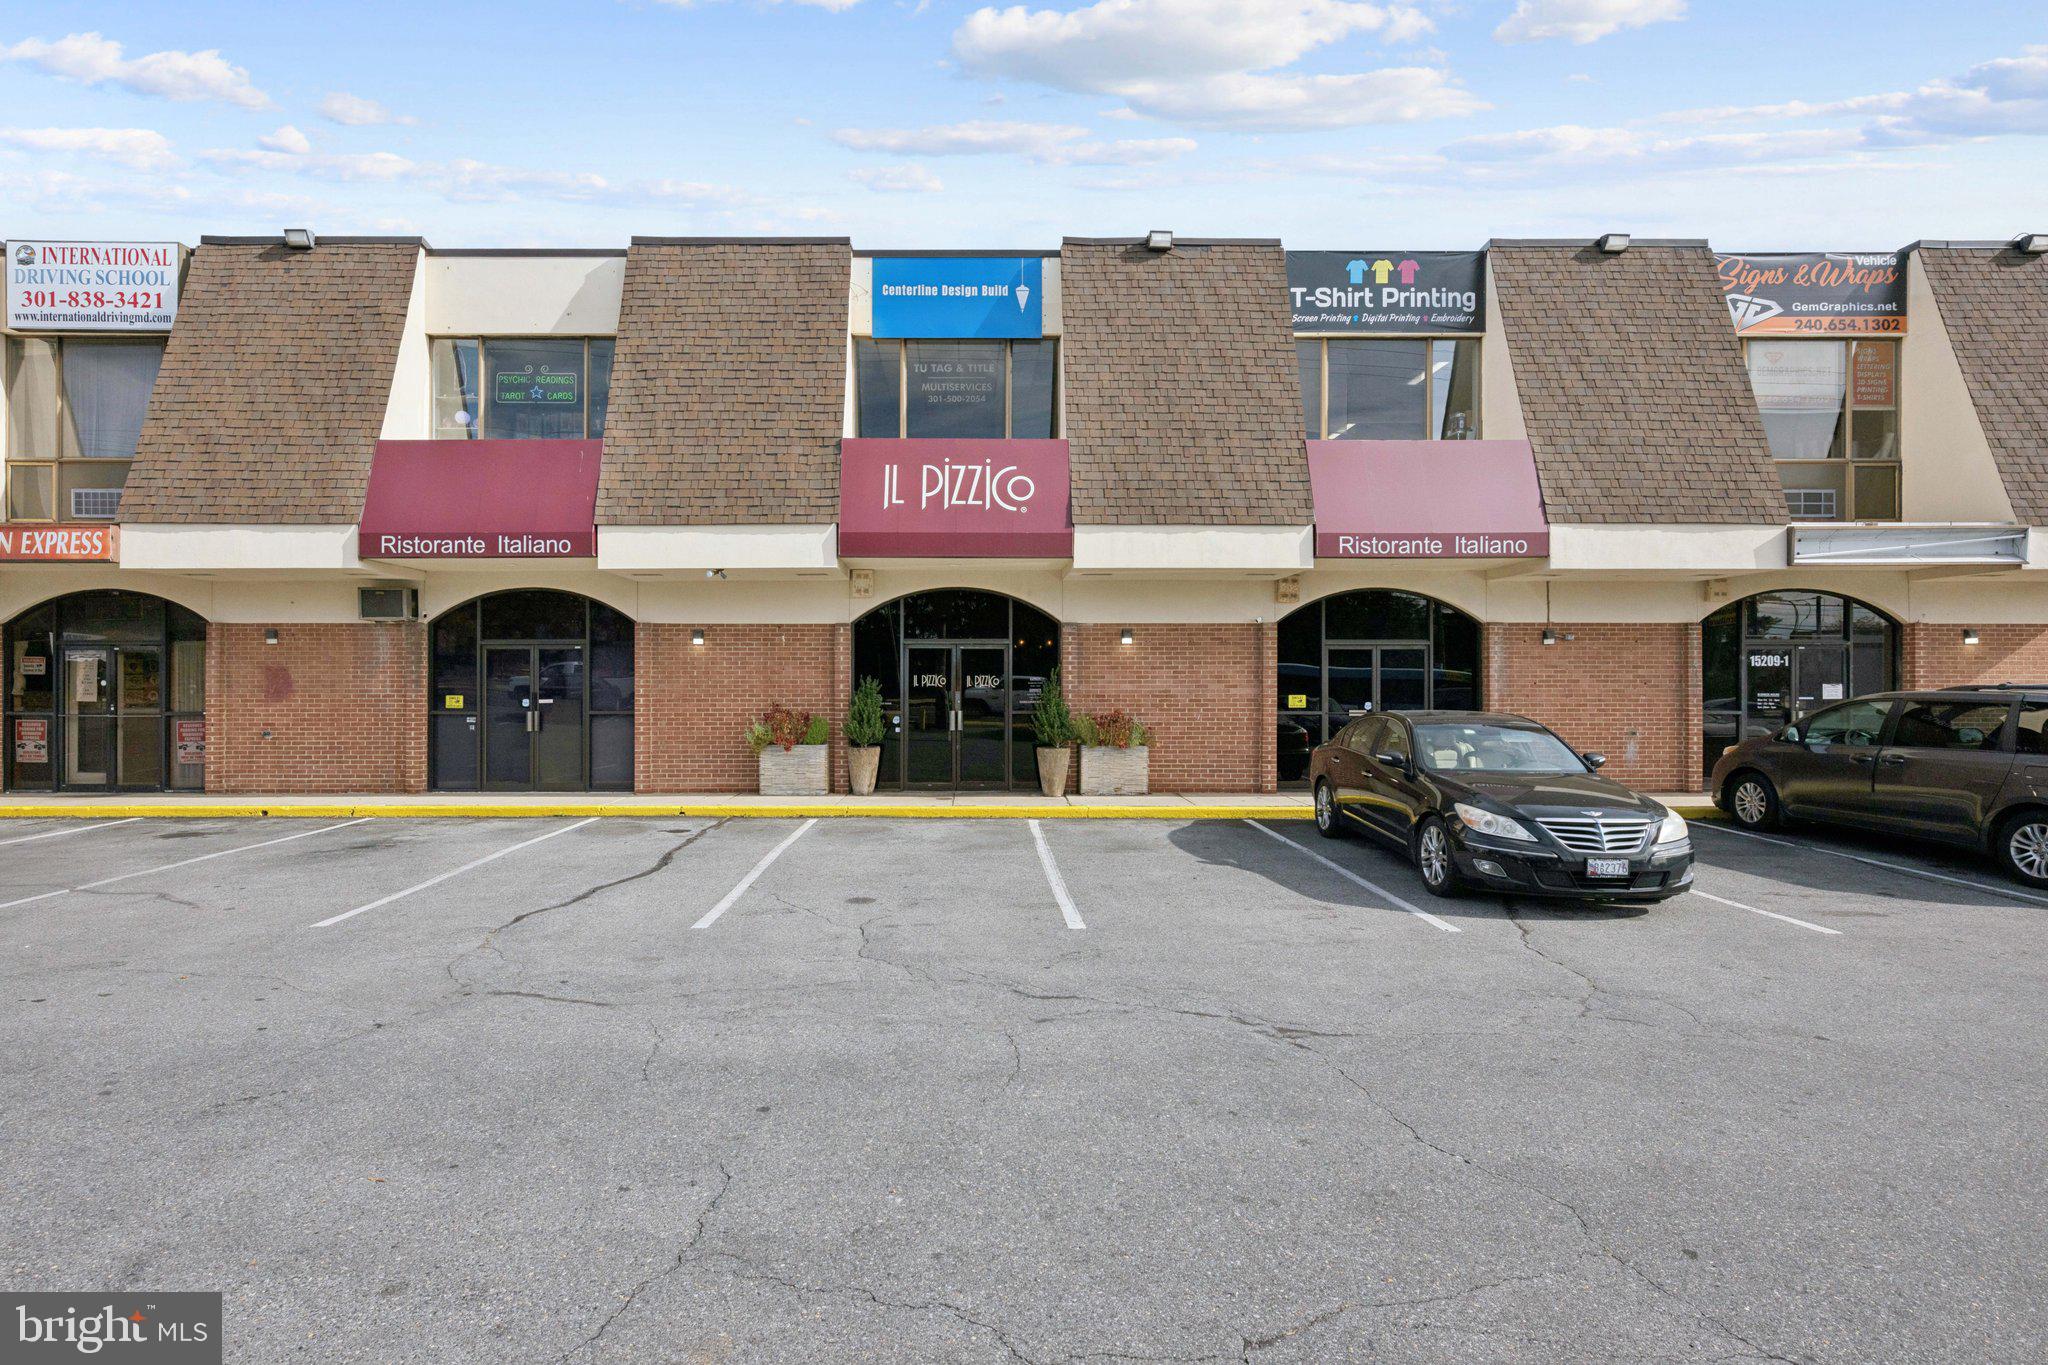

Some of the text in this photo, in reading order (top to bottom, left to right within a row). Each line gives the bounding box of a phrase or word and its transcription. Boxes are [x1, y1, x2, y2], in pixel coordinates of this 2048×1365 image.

[41, 246, 172, 267] INTERNATIONAL
[1854, 255, 1898, 266] Vehicle
[14, 268, 171, 286] DRIVING SCHOOL
[1716, 257, 1899, 295] Signs & Wraps
[882, 284, 1009, 298] Centerline Design Build
[21, 290, 163, 309] 301-838-3421
[1290, 287, 1476, 312] T-Shirt Printing
[1791, 302, 1898, 313] GemGraphics.net
[14, 310, 172, 325] www.internationaldrivingmd.com
[1292, 313, 1475, 325] Screen Printing Digital Printing Embroidery
[1794, 319, 1900, 331] 240.654.1302
[913, 363, 928, 373] TU
[930, 363, 953, 373] TAG
[967, 363, 995, 373] TITLE
[498, 375, 575, 385] PSYCHIC READINGS
[921, 383, 993, 392] MULTISERVICES
[501, 392, 573, 400] TAROT CARDS
[20, 531, 103, 555] EXPRESS
[380, 534, 571, 554] Ristorante Italiano
[1339, 535, 1528, 554] Ristorante Italiano
[1749, 655, 1789, 667] 15209-1
